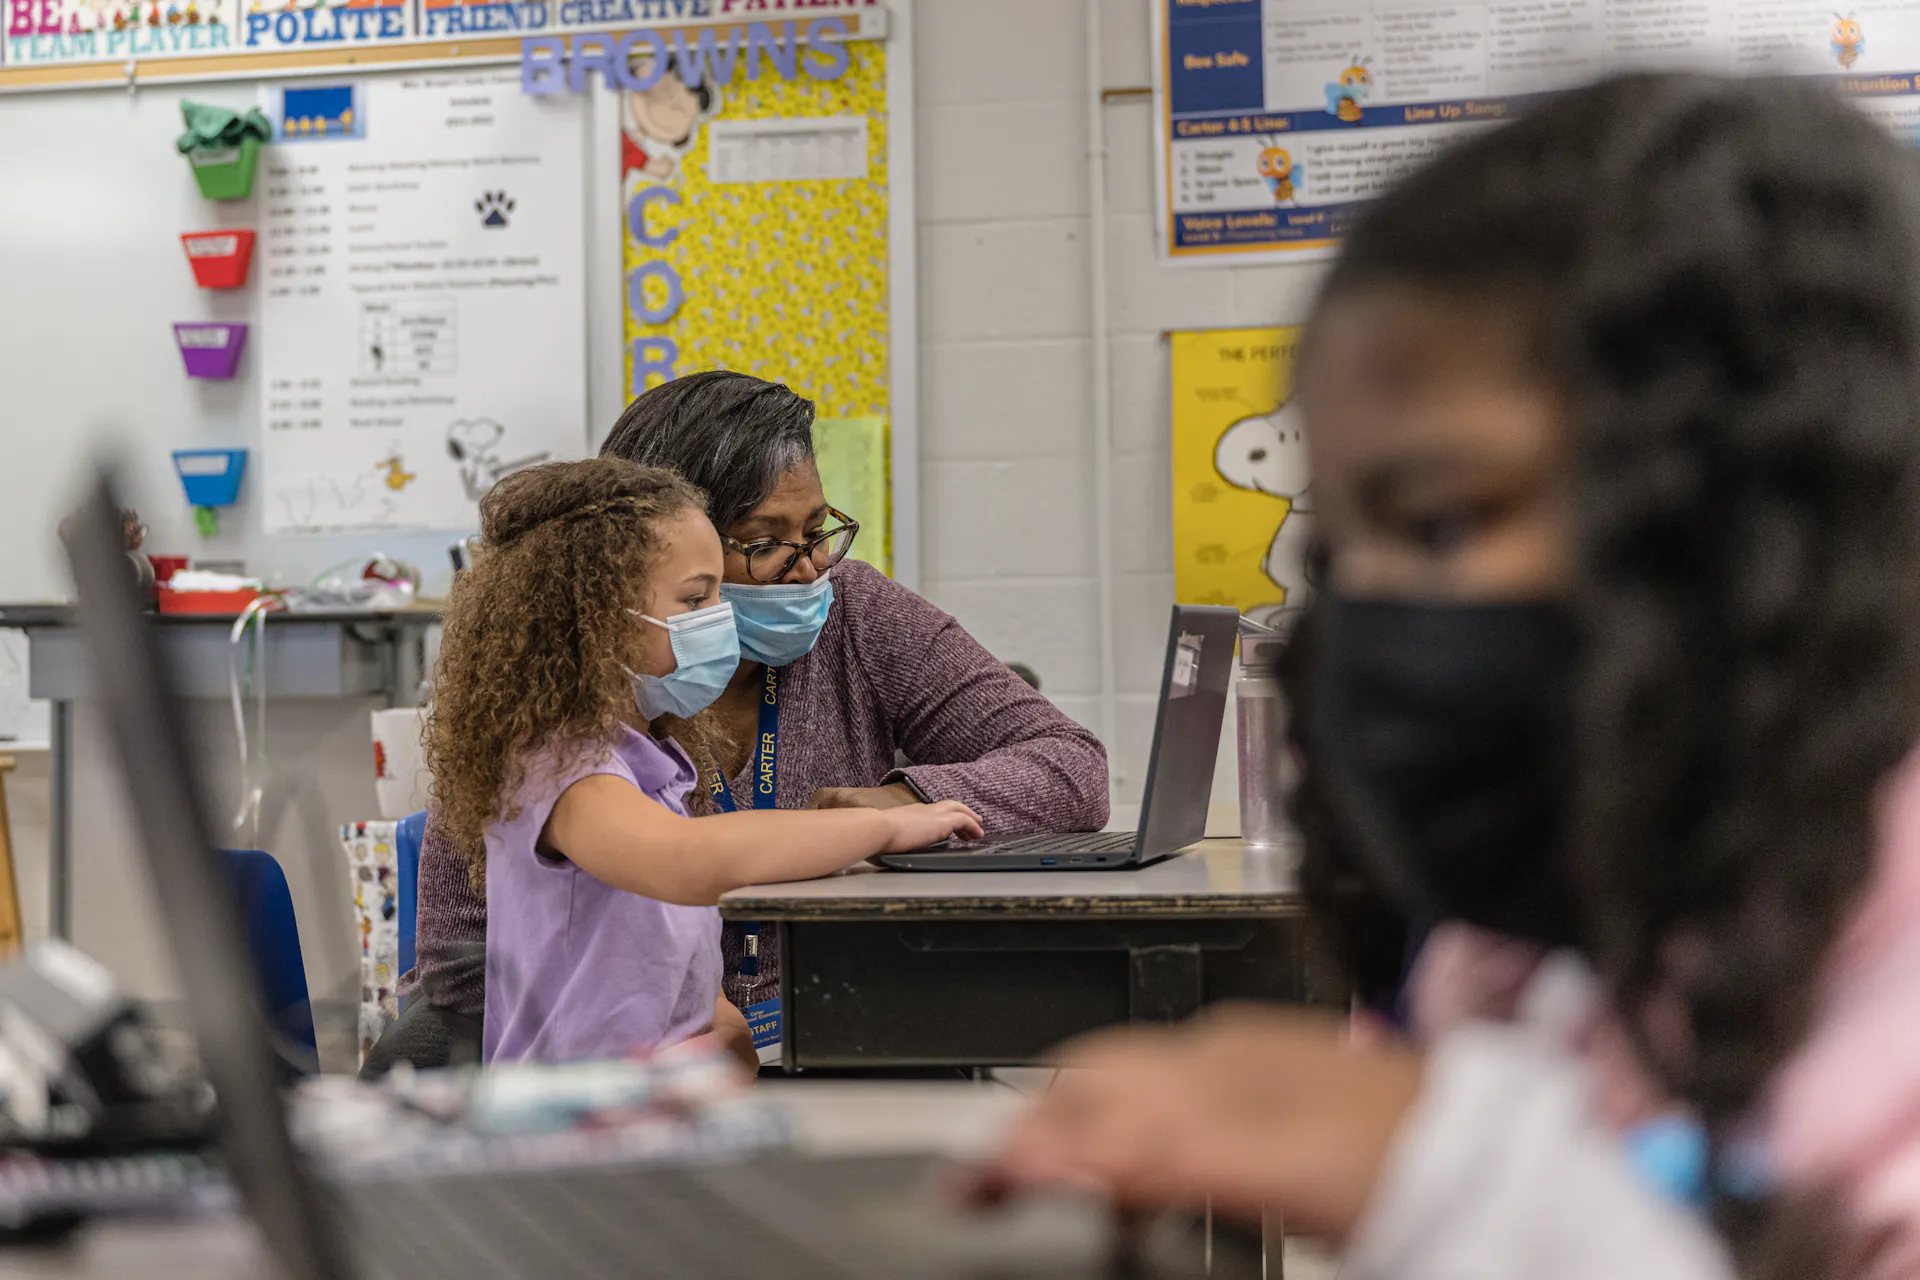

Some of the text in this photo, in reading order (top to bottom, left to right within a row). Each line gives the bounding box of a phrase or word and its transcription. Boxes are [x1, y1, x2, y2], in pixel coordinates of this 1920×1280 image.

[246, 7, 405, 46] POLITE
[426, 3, 548, 35] FRIEND
[560, 0, 711, 25] CREATIVE
[10, 24, 230, 60] TEAM PLAYER
[522, 17, 850, 94] BROWNS
[1215, 50, 1249, 68] Safe
[1178, 120, 1225, 136] Carter
[1405, 105, 1435, 121] Line
[1440, 103, 1461, 119] Up
[764, 665, 777, 705] CART
[759, 732, 775, 794] CARTER
[750, 1020, 777, 1036] STAFF
